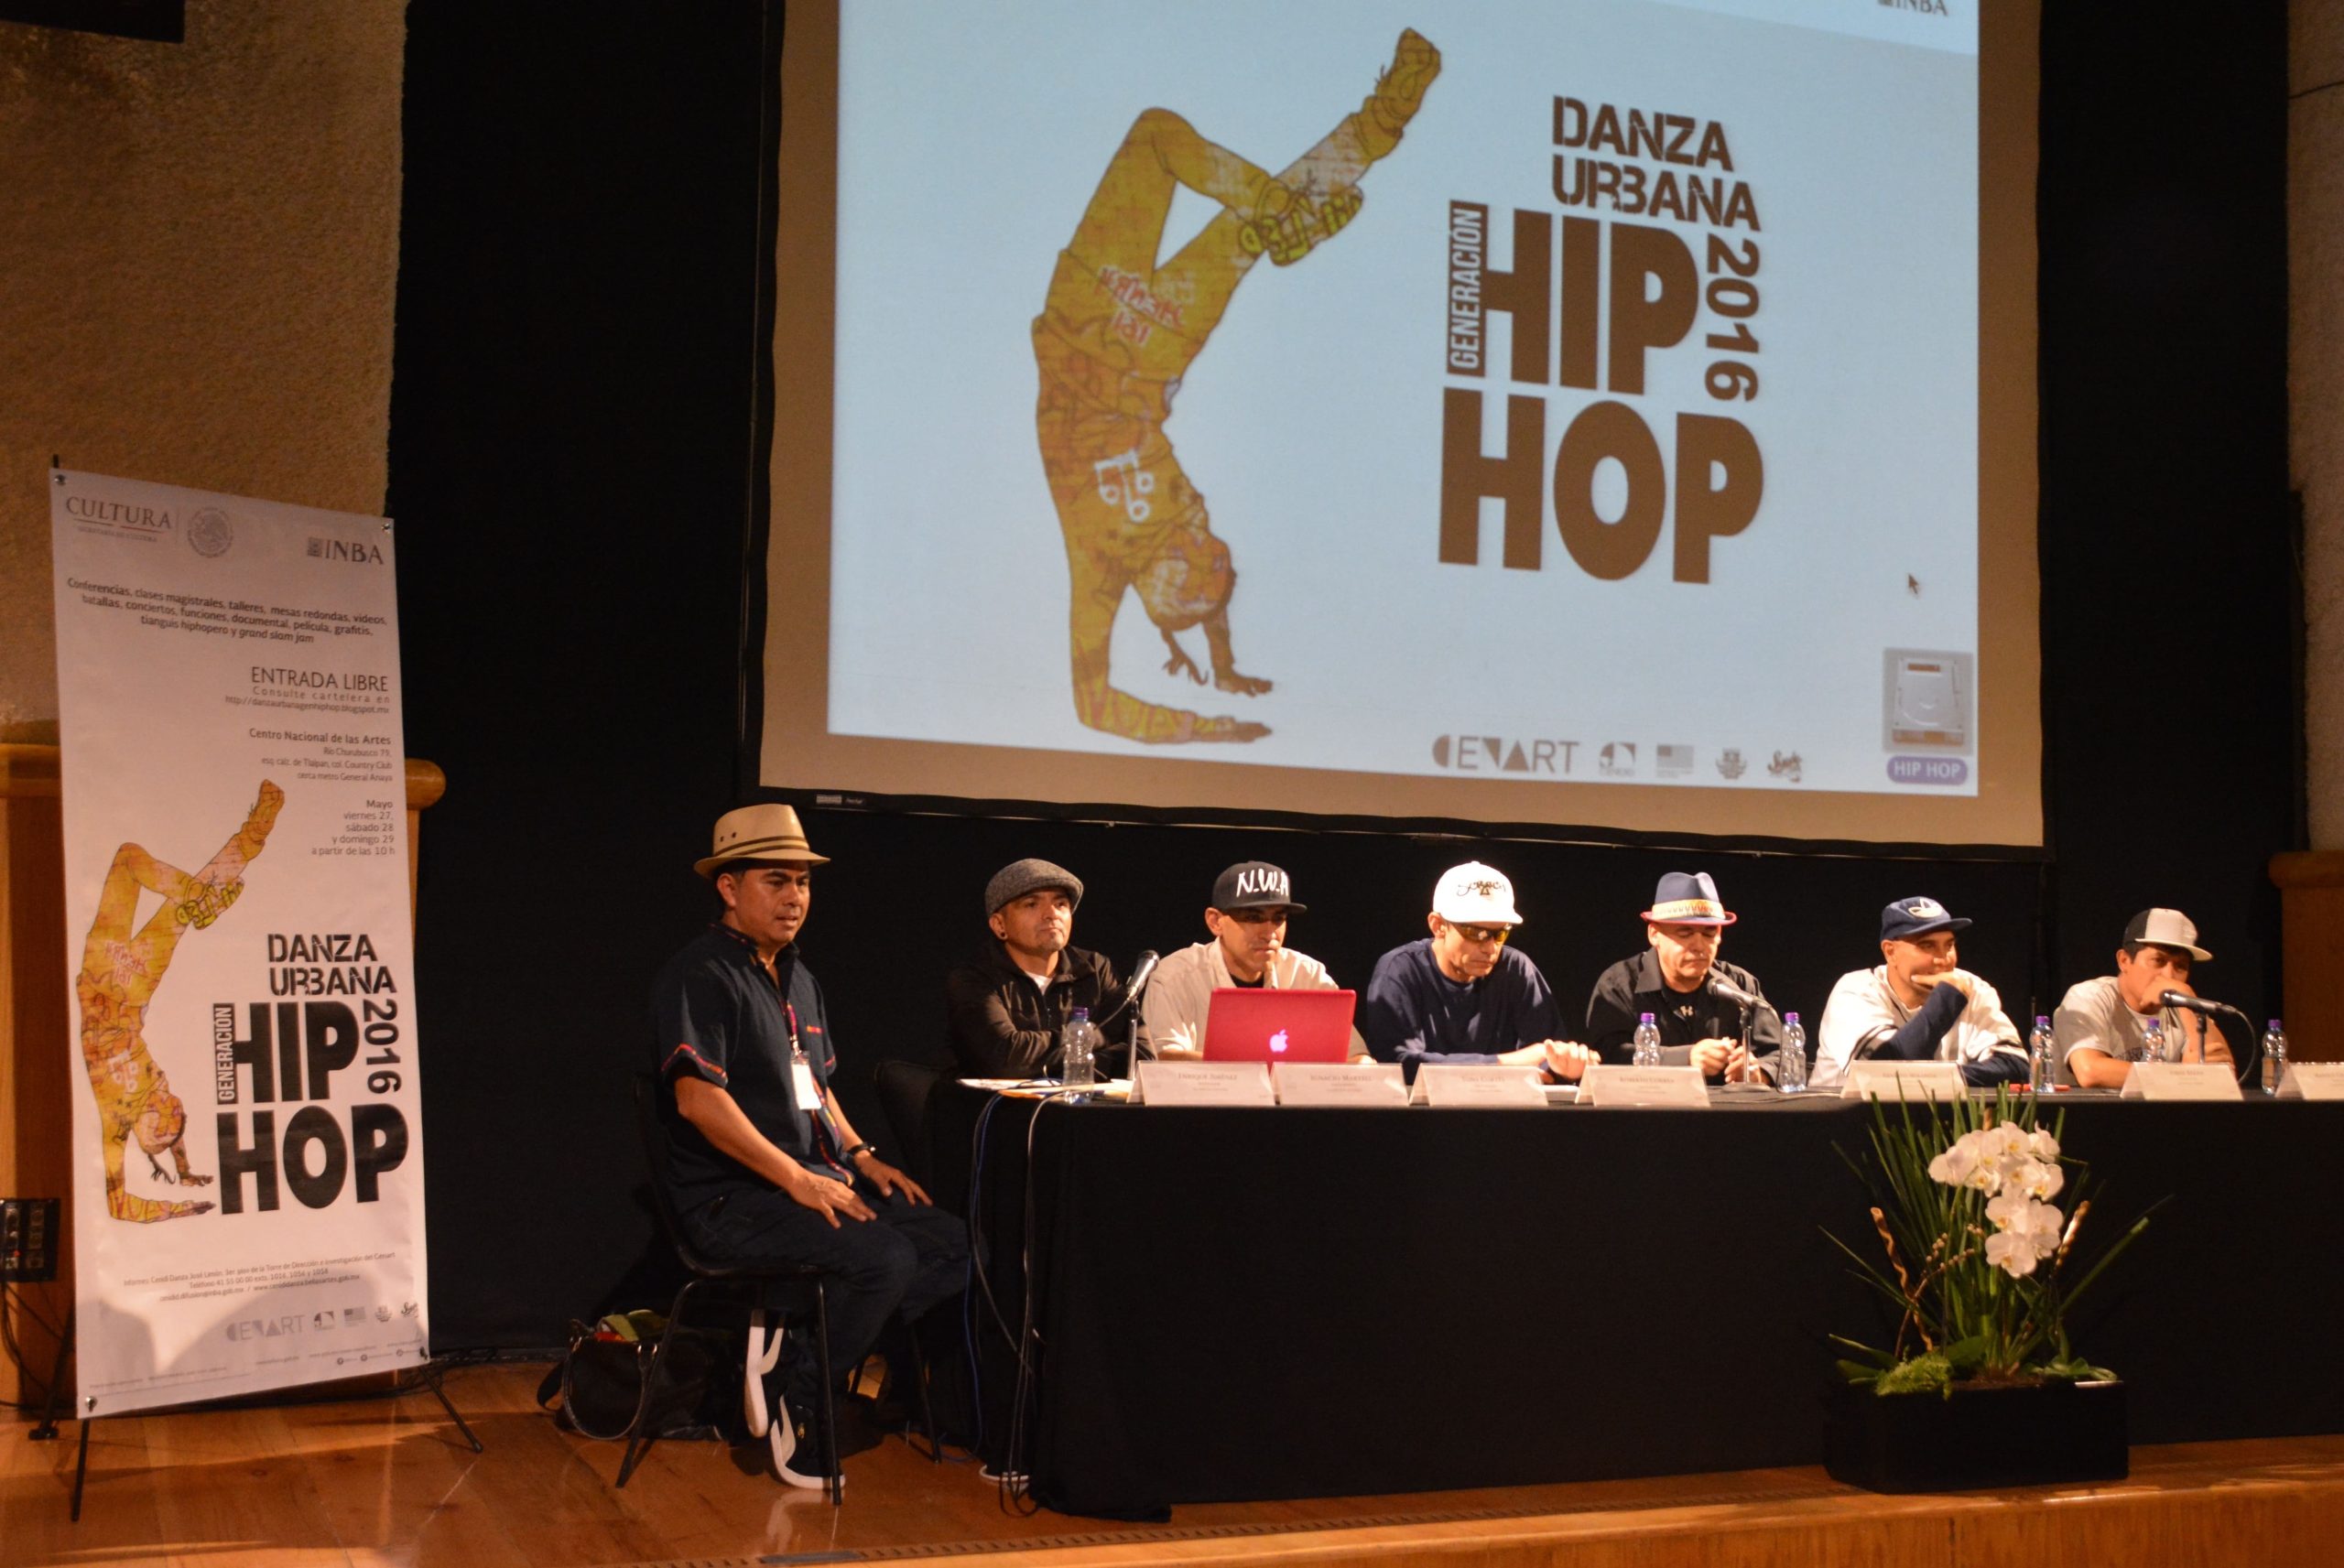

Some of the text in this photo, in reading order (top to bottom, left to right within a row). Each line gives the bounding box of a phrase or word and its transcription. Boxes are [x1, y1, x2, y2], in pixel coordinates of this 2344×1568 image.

[1553, 94, 1734, 173] DANZA
[1552, 154, 1762, 232] URBANA
[1447, 199, 1698, 396] HIP
[1449, 208, 1481, 370] GENERACIÓN
[1704, 232, 1761, 403] 2016
[1438, 386, 1763, 585] HOP
[66, 496, 171, 529] CULTURA
[325, 539, 384, 565] INBA
[68, 578, 133, 597] Conferencias,
[135, 589, 163, 600] clases
[166, 593, 226, 609] magistrales,
[229, 600, 266, 614] talleres,
[270, 607, 300, 617] mesas
[303, 610, 351, 622] redondas,
[81, 594, 123, 610] batallas,
[125, 600, 179, 616] conciertos,
[180, 606, 229, 623] funciones,
[141, 615, 314, 643] tianguis hiphopero y grand slam jam
[252, 666, 388, 692] ENTRADA LIBRE
[253, 686, 390, 704] Consulte cartelera en
[249, 728, 391, 745] Centro Nacional de las Artes
[340, 773, 368, 782] General
[344, 761, 374, 771] Country
[375, 762, 392, 770] Club
[1894, 761, 1960, 778] HIP HOP
[343, 811, 376, 820] viernes
[366, 799, 394, 810] Mayo
[331, 834, 395, 846] y domingo 29
[346, 822, 394, 832] sábado 28
[319, 847, 342, 857] partir
[346, 847, 357, 855] de
[359, 847, 372, 856] las
[375, 847, 386, 855] 10
[389, 847, 395, 855] h
[267, 934, 377, 962] DANZA
[269, 966, 397, 996] URBANA
[213, 1000, 360, 1105] HIP
[216, 1007, 235, 1101] GENERACIÓN
[363, 998, 402, 1095] 2016
[216, 1103, 409, 1215] HOP
